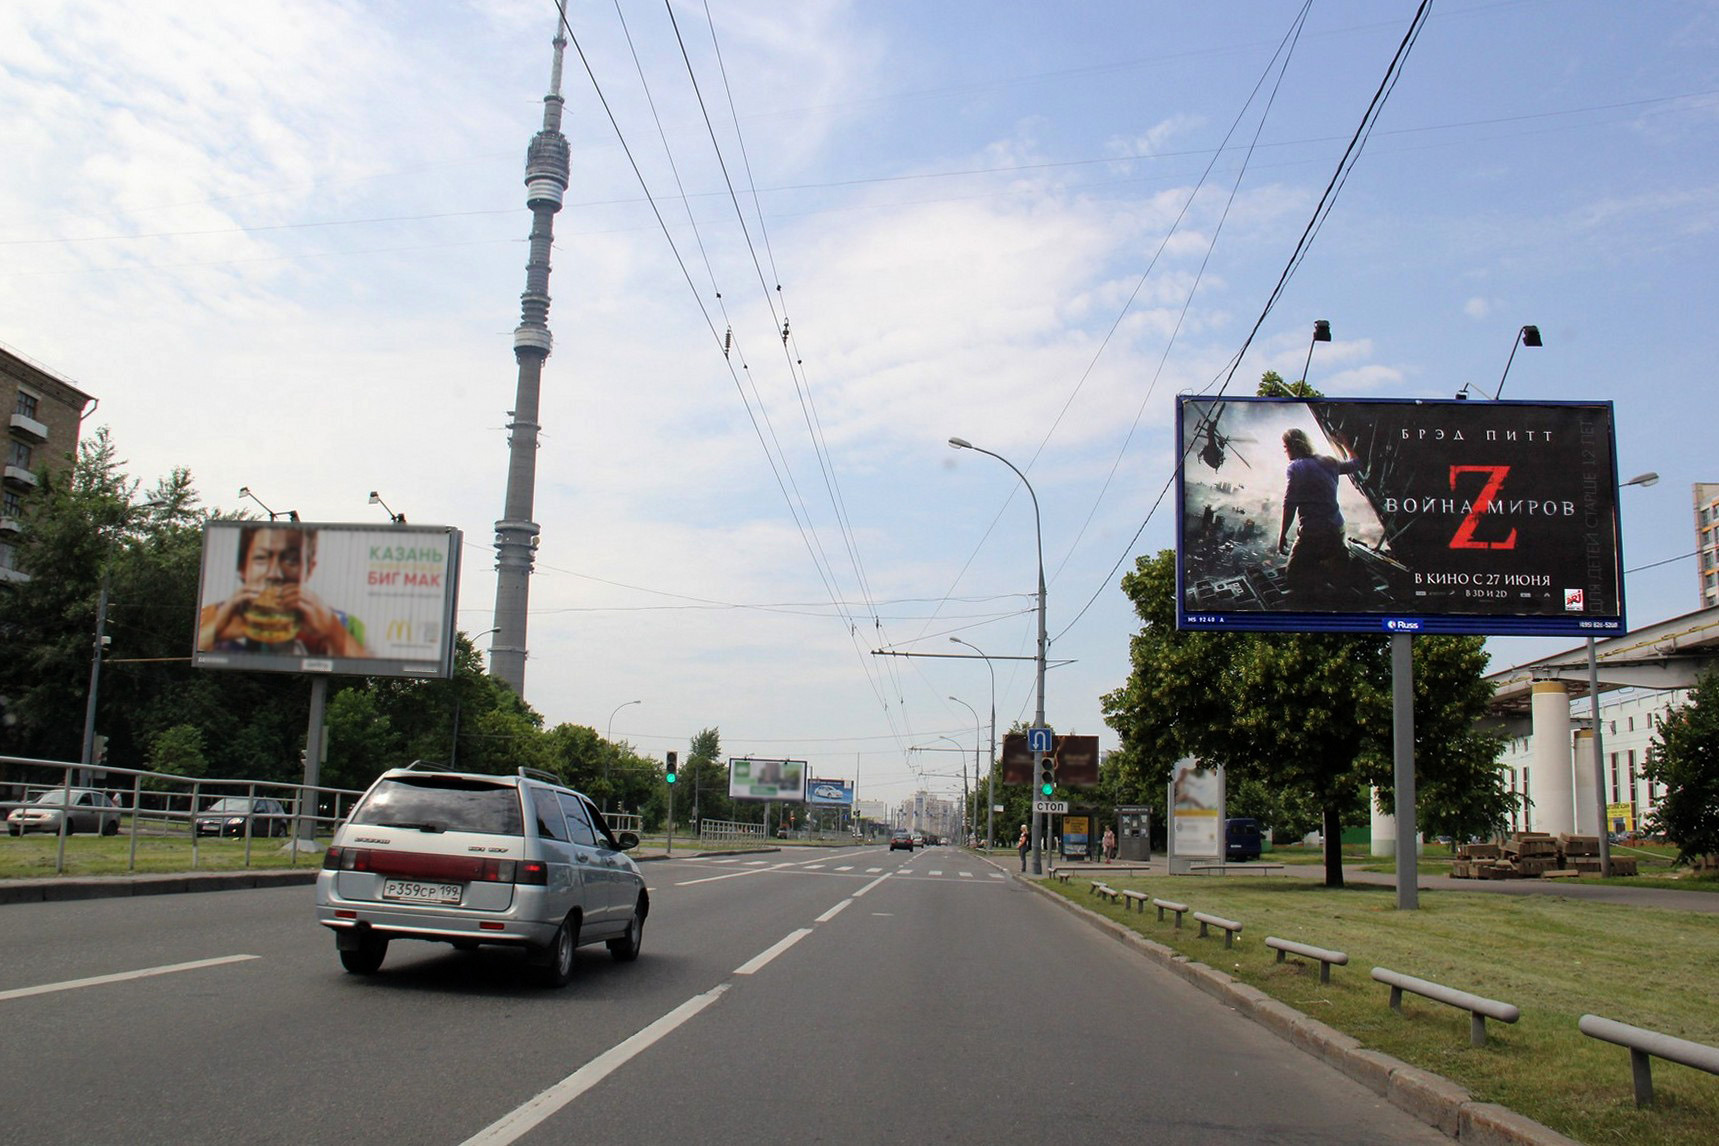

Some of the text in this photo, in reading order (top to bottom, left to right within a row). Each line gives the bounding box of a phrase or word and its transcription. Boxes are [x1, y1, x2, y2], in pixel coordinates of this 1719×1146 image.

[1401, 428, 1552, 442] БРЭД ПИТТ
[1386, 496, 1576, 516] ВОЙНА МИРОВ
[1449, 465, 1517, 550] Z
[369, 545, 443, 562] КАЗАНЬ
[367, 570, 442, 588] БИГ МАК
[1414, 573, 1550, 586] В КИНО С 27 ИЮНЯ
[1465, 589, 1471, 597] В
[1472, 589, 1485, 597] 3D
[1486, 590, 1494, 598] И
[1495, 590, 1508, 598] 2D
[1397, 620, 1419, 629] Russ
[1037, 802, 1064, 811] СТОП
[388, 882, 458, 897] Р359СР 199
